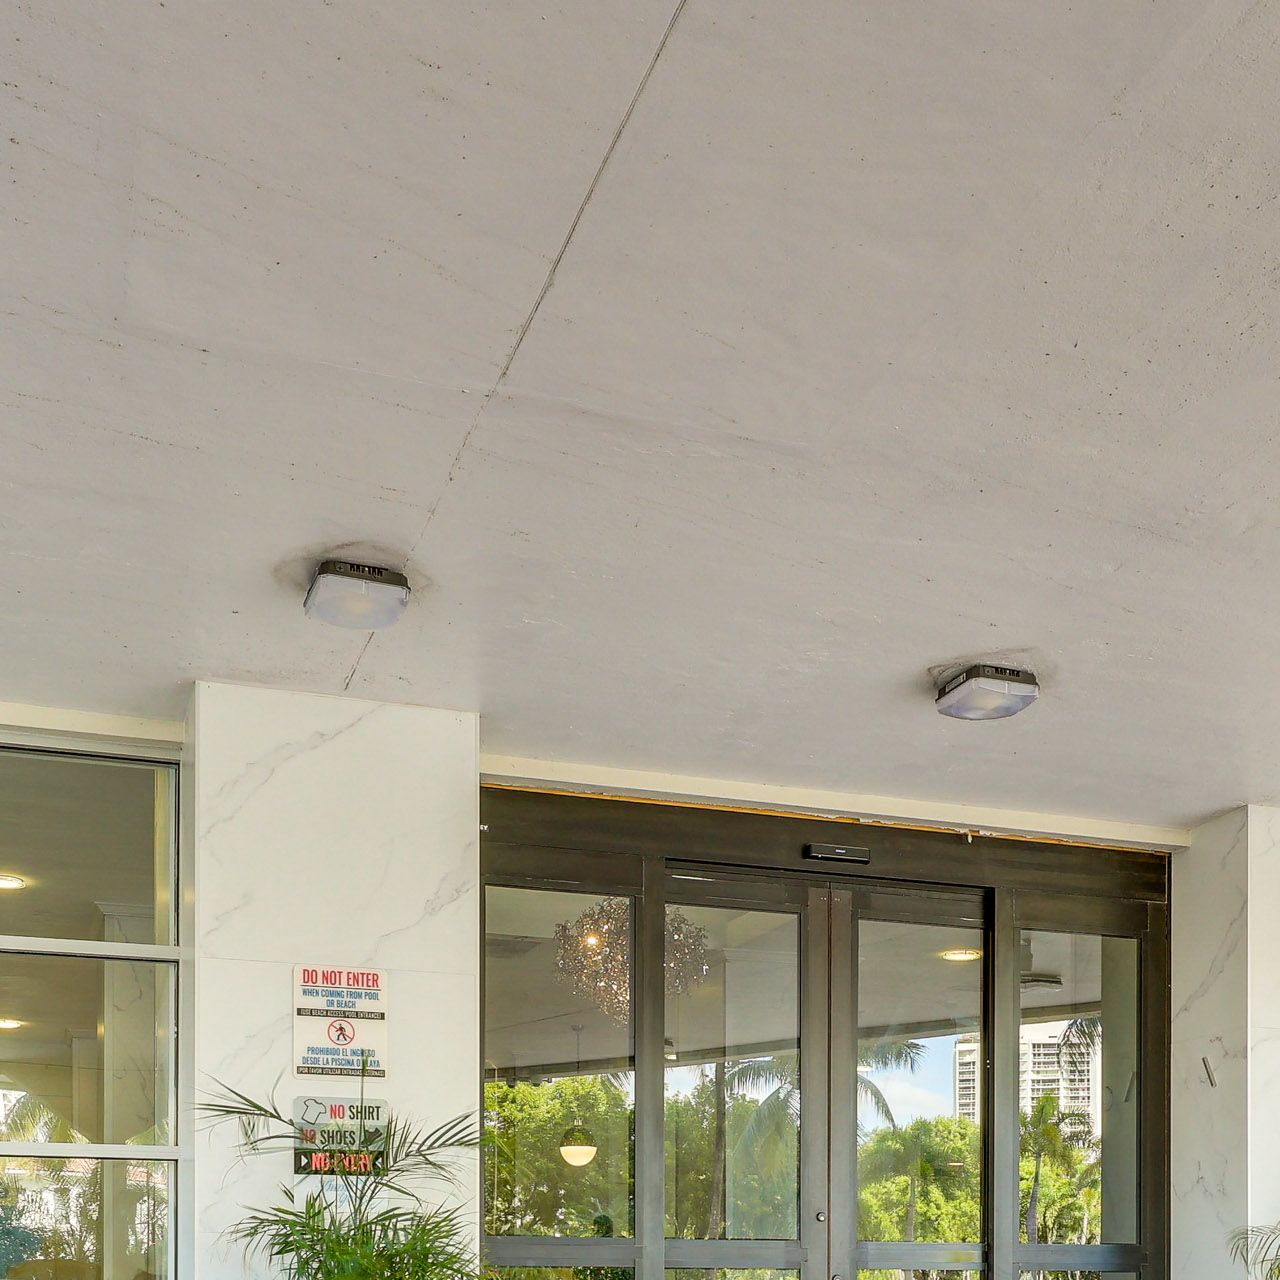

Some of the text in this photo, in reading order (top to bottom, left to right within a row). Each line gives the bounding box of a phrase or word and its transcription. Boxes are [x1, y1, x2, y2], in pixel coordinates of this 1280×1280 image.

[303, 969, 379, 988] DO NOT ENTER
[302, 988, 380, 1001] WHEN COMING FROM POOL
[326, 999, 356, 1009] OR BEACH
[307, 1046, 340, 1056] PROHIBIDO
[342, 1048, 348, 1056] EL
[302, 1056, 321, 1065] DESDE
[322, 1057, 330, 1066] LA
[331, 1058, 355, 1067] PISCINA
[330, 1104, 381, 1120] NO SHIRT
[302, 1129, 356, 1145] NO SHOES
